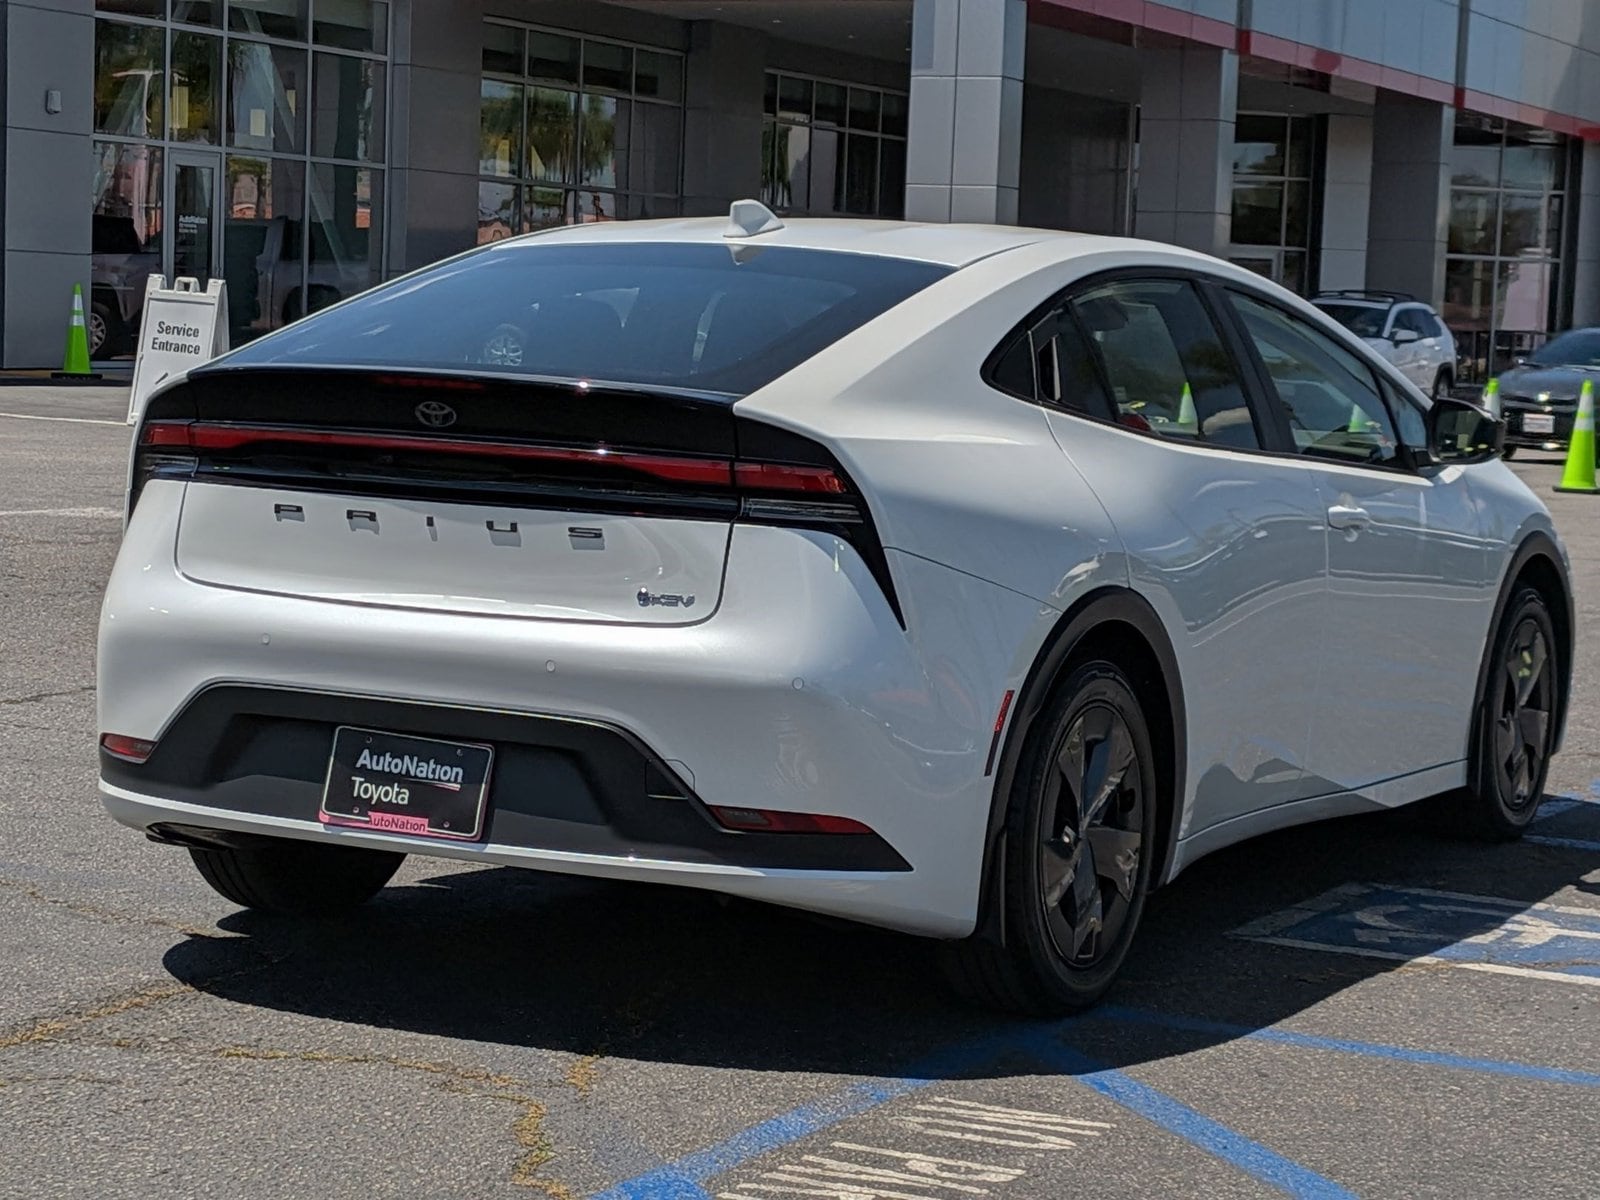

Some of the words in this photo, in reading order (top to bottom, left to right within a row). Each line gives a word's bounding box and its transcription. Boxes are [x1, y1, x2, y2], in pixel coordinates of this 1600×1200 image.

[157, 321, 200, 338] Service
[151, 337, 200, 355] Entrance
[274, 503, 603, 539] PRIUS
[355, 748, 463, 784] AutoNation
[351, 776, 410, 805] Toyota
